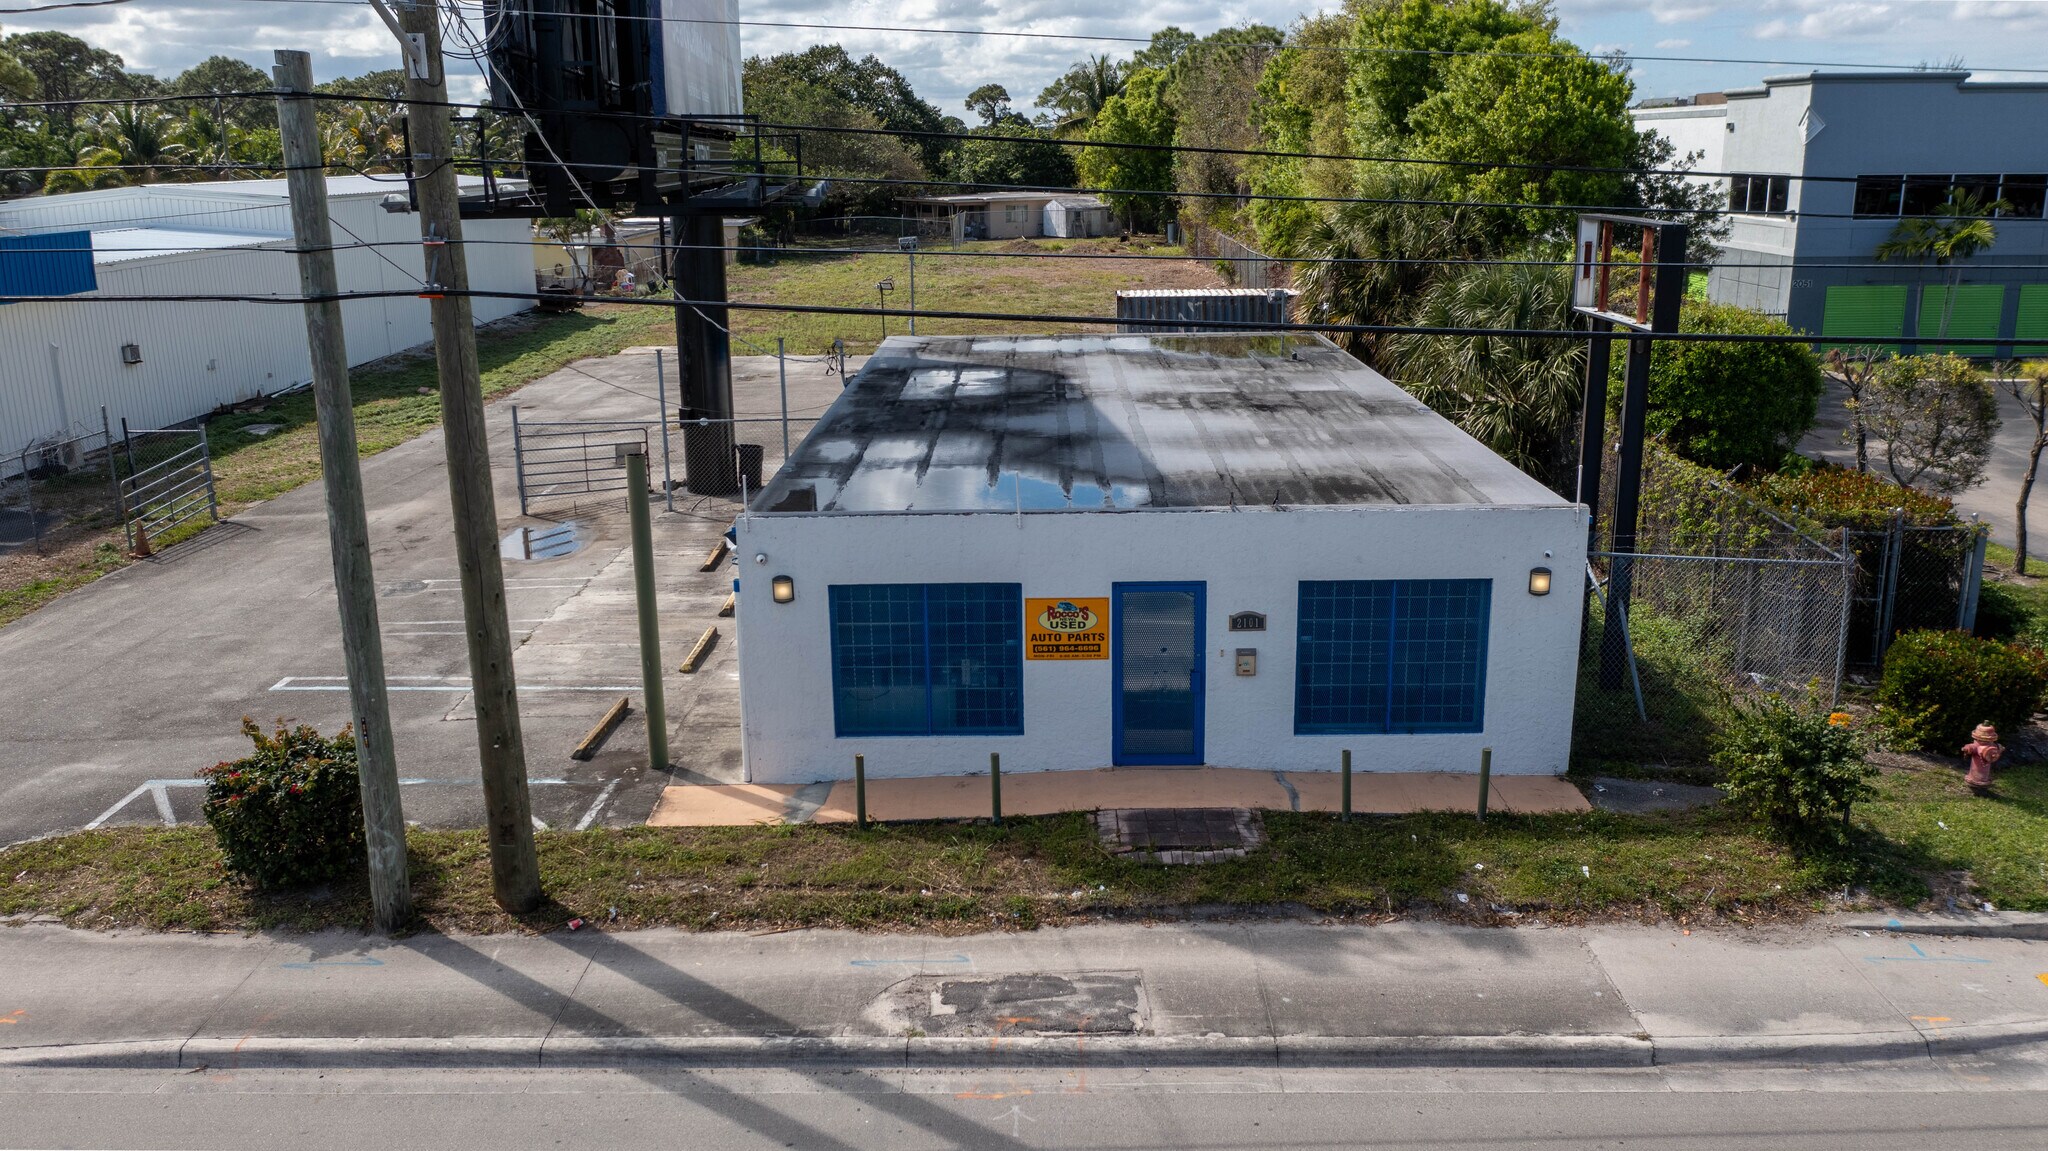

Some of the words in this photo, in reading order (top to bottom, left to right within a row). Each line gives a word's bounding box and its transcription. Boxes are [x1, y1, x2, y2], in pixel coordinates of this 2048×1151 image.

[1793, 280, 1812, 288] 2051
[1047, 605, 1090, 621] ROCCO'S
[1049, 621, 1087, 629] USED
[1236, 617, 1259, 628] 2101
[1030, 633, 1062, 642] AUTO
[1067, 632, 1105, 642] PARTS
[1034, 645, 1056, 653] (561)
